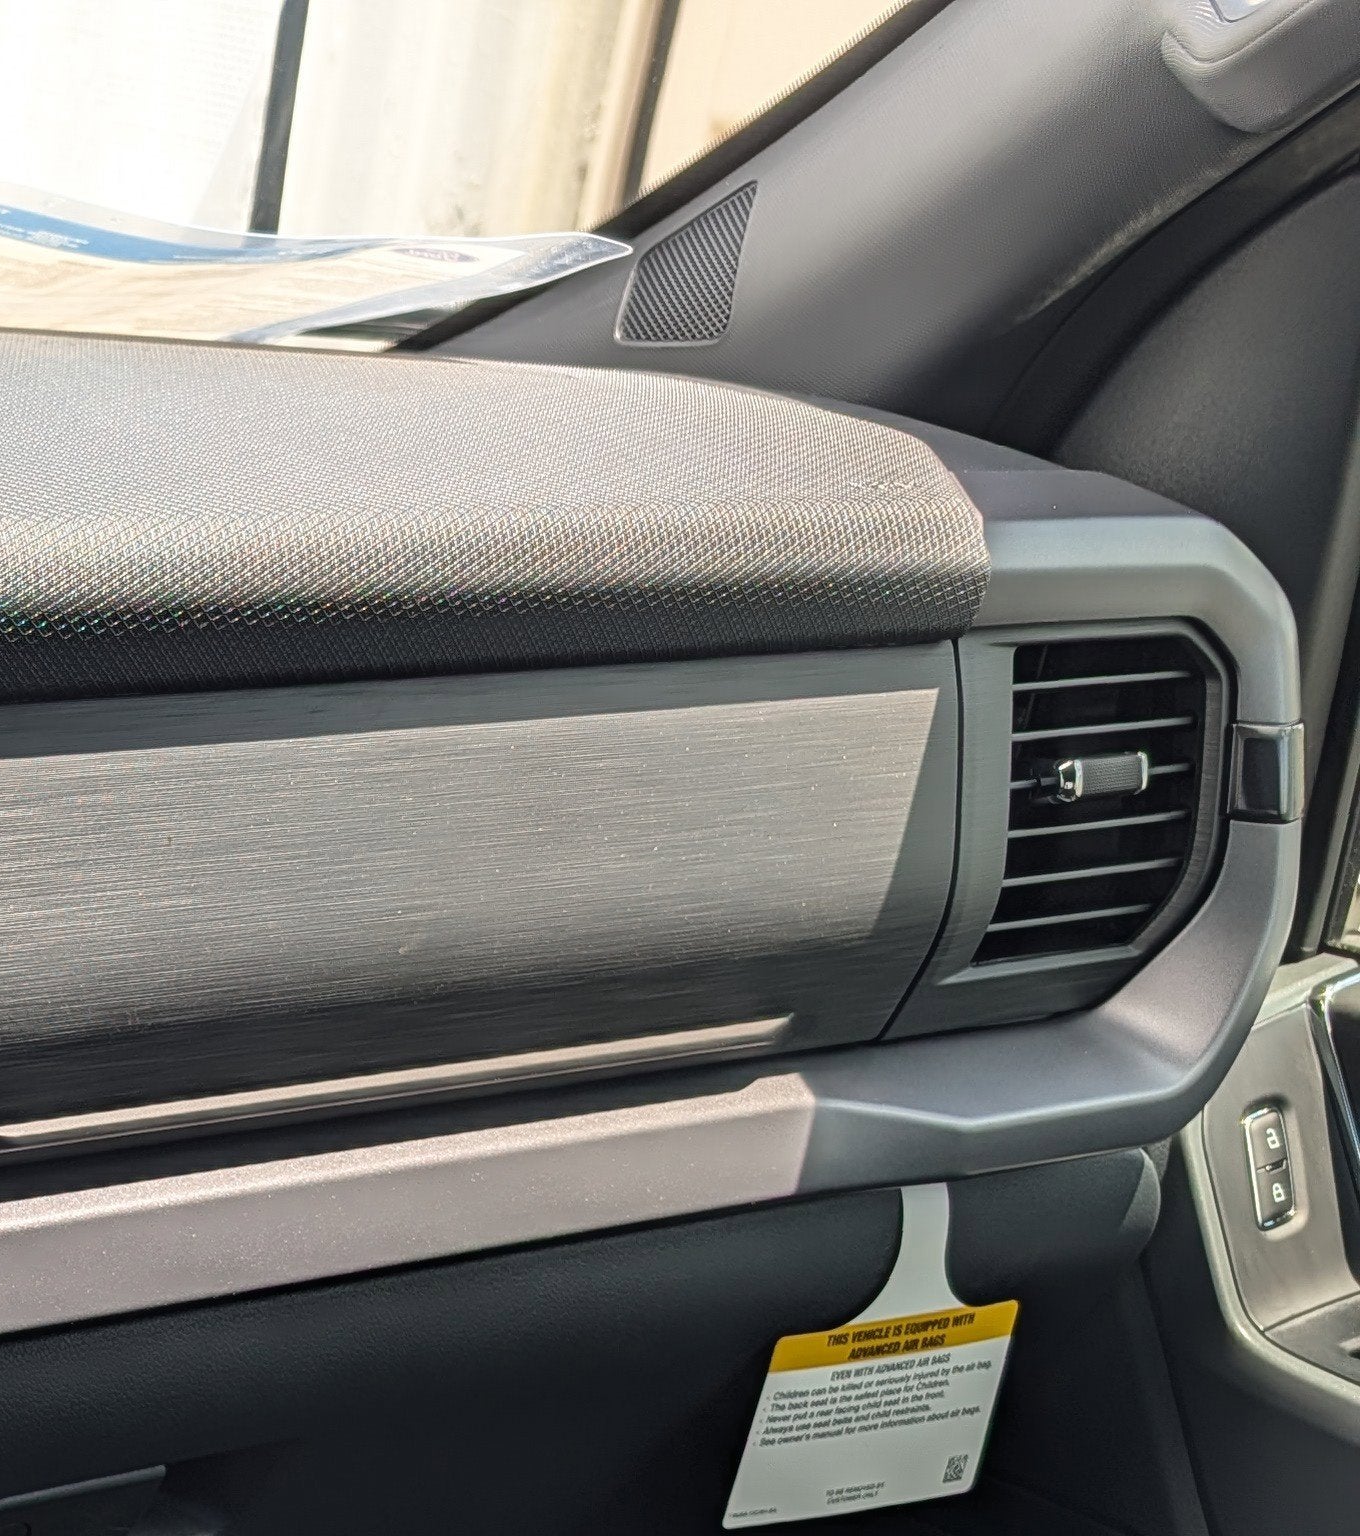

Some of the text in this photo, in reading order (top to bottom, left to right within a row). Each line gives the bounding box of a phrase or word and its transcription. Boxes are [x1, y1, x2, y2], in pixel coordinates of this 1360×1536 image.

[826, 1313, 975, 1346] THIS VEHICLE IS EQUIPPED WITH
[848, 1334, 946, 1358] ADVANCED AIR BAGS
